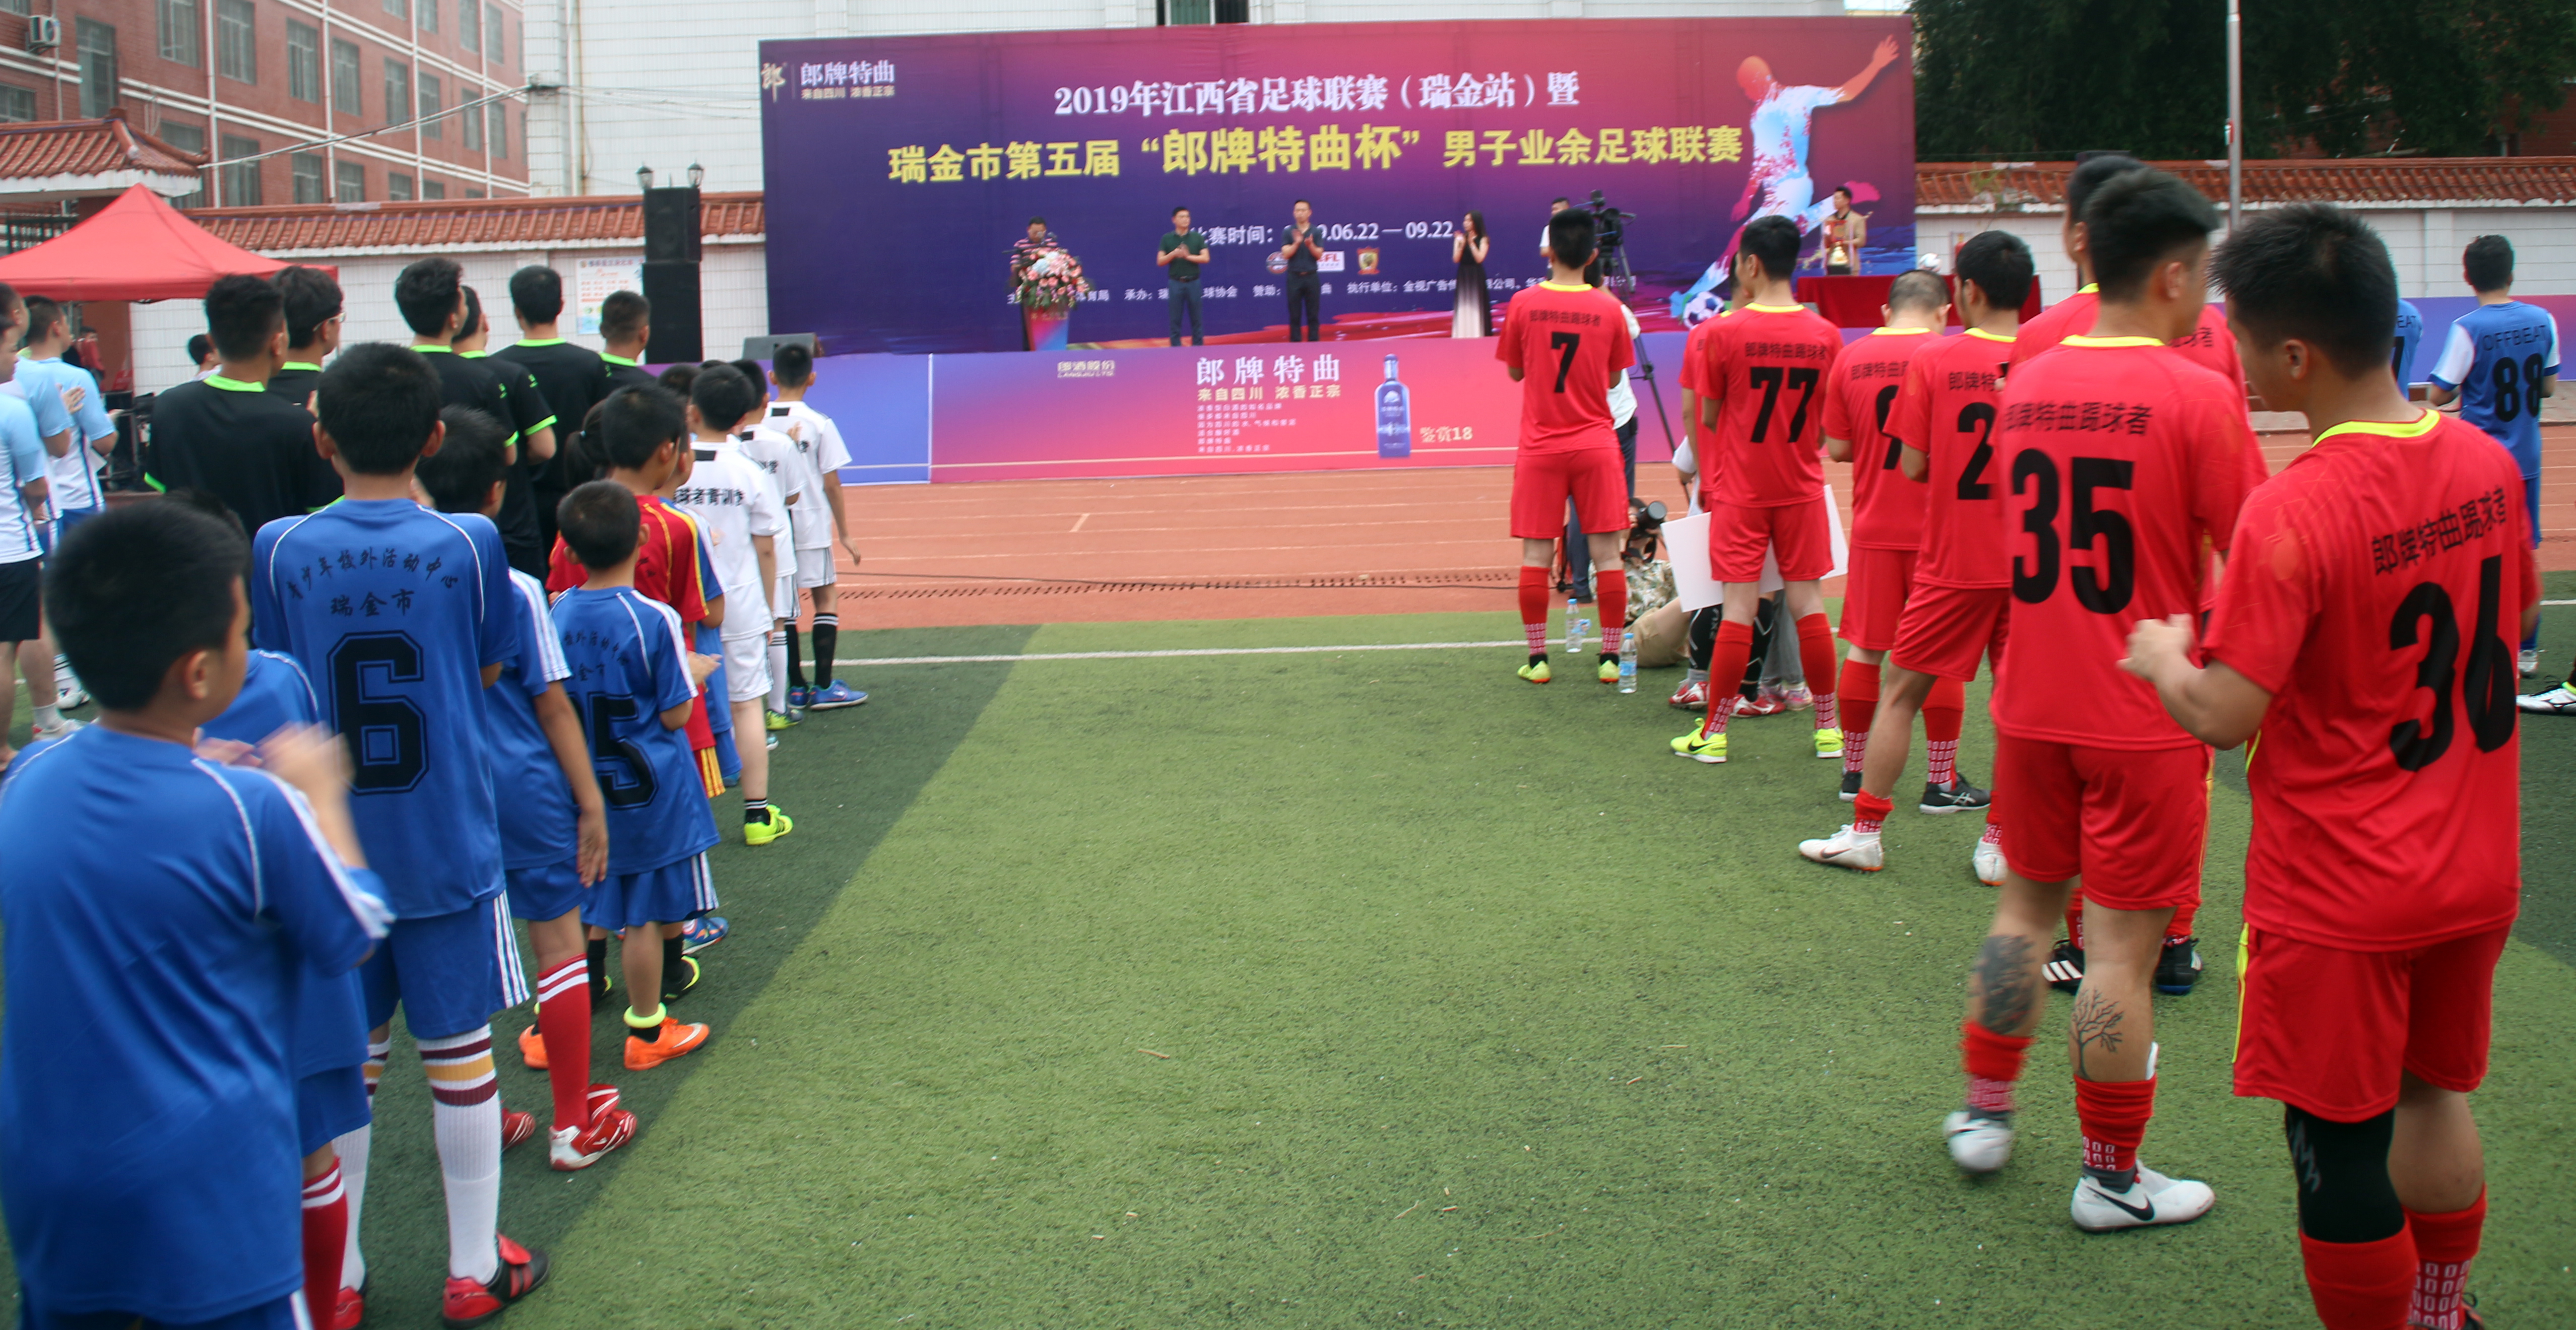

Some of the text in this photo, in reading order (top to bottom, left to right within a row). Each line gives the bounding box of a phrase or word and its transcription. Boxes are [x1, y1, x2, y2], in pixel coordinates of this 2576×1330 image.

[800, 59, 895, 86] 郎牌特曲
[1551, 331, 1580, 393] 7
[2482, 324, 2546, 352] OFFBEAT
[1196, 354, 1340, 386] 郎牌特曲
[1197, 384, 1340, 401] 来自四川 浓香正宗
[2492, 353, 2544, 422] 88
[1750, 366, 1821, 443] 77
[2011, 448, 2135, 615] 35
[331, 588, 415, 617] 瑞金市
[2390, 554, 2517, 772] 36
[326, 630, 430, 796] 6
